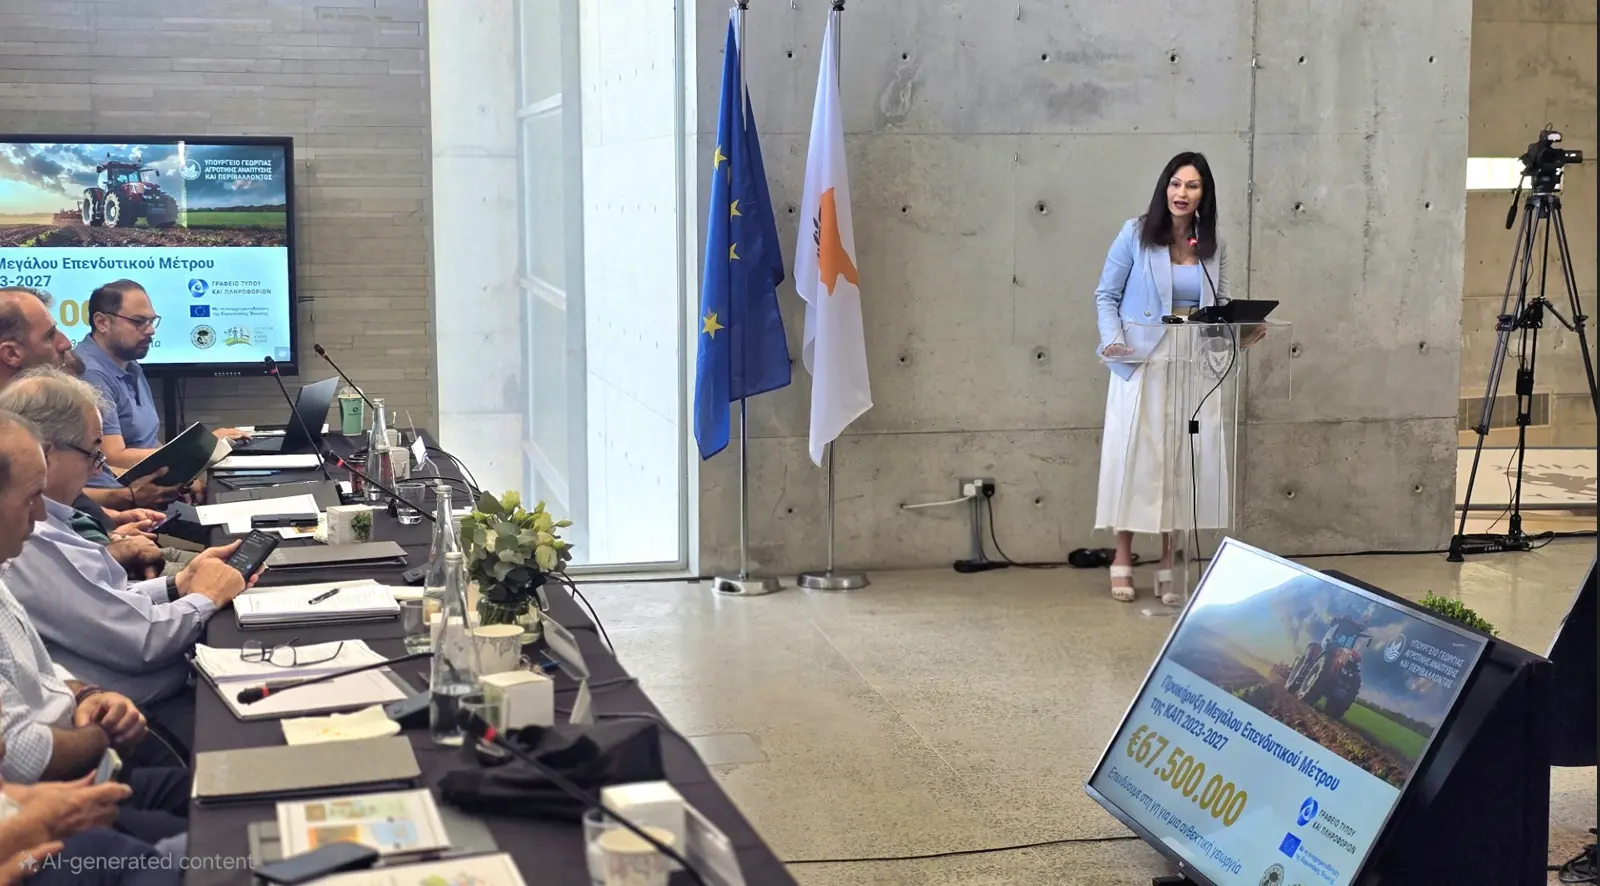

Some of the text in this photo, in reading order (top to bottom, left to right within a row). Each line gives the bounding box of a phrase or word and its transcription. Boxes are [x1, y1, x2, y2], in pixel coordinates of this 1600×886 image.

[62, 257, 155, 269] Επενδυτικού
[159, 257, 214, 271] Μέτρου
[1410, 640, 1464, 668] ΥΠΟΥΡΓΕΙΟ ΓΕΩΡΓΙΑΣ
[1399, 660, 1454, 688] ΚΑΙ ΠΕΡΙΒΑΛΛΟΝΤΟΣ
[1150, 697, 1229, 752] της ΚΑΠ 2023-2027
[1160, 675, 1341, 791] Προκήρυξη Μεγάλου Επενδυτικού Μέτρου
[1126, 724, 1248, 827] €67.500.000
[1139, 792, 1154, 810] στη
[1149, 799, 1161, 816] γη
[1158, 805, 1172, 822] για
[1167, 813, 1182, 830] μια
[1179, 821, 1216, 856] ανθεκτική
[1210, 844, 1243, 876] γεωργία
[1312, 821, 1357, 855] ΚΑΙ ΠΛΗΡΟΦΟΡΙΩΝ
[1319, 809, 1357, 837] ΓΡΑΦΕΙΟ ΤΥΠΟΥ
